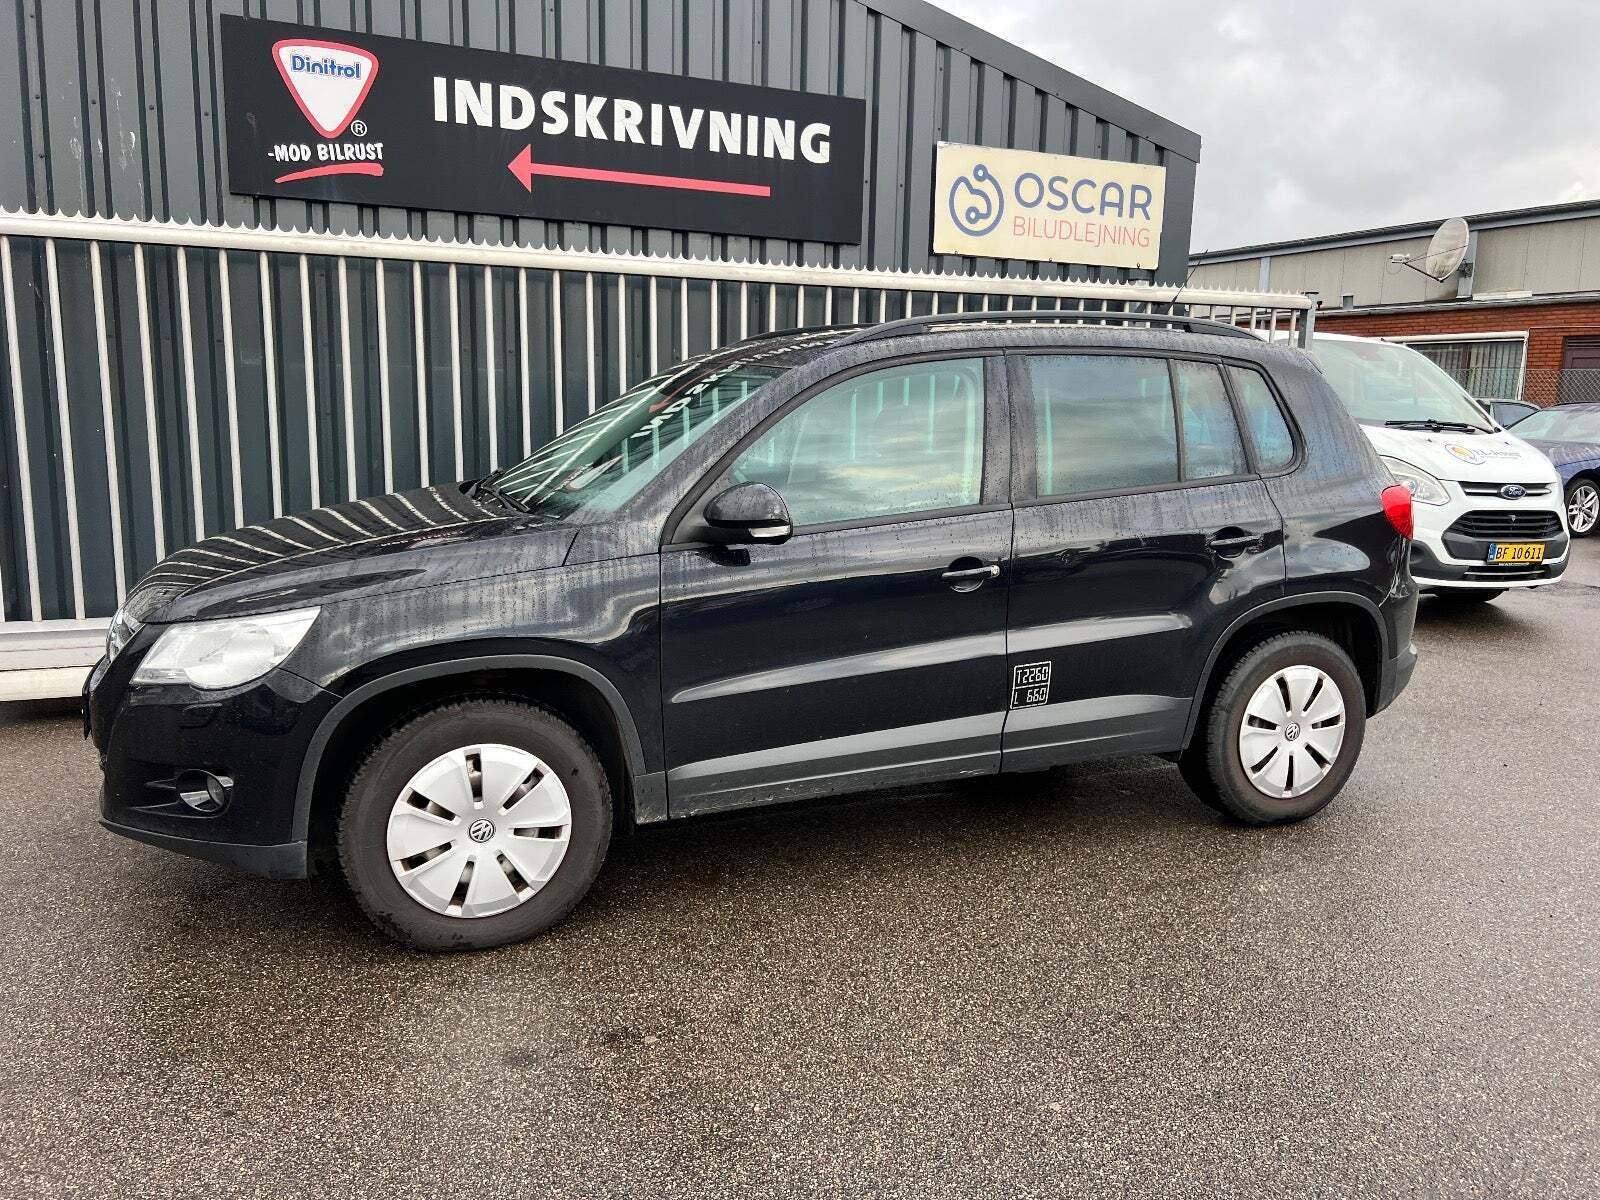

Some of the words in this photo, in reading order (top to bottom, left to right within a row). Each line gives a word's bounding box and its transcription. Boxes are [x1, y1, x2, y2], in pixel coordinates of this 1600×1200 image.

[291, 54, 361, 79] Dinitrol
[433, 76, 831, 164] INDSKRIVNING
[317, 142, 384, 161] BILRUST
[1014, 172, 1152, 220] OSCAR
[1013, 216, 1150, 247] BILUDLEJNING
